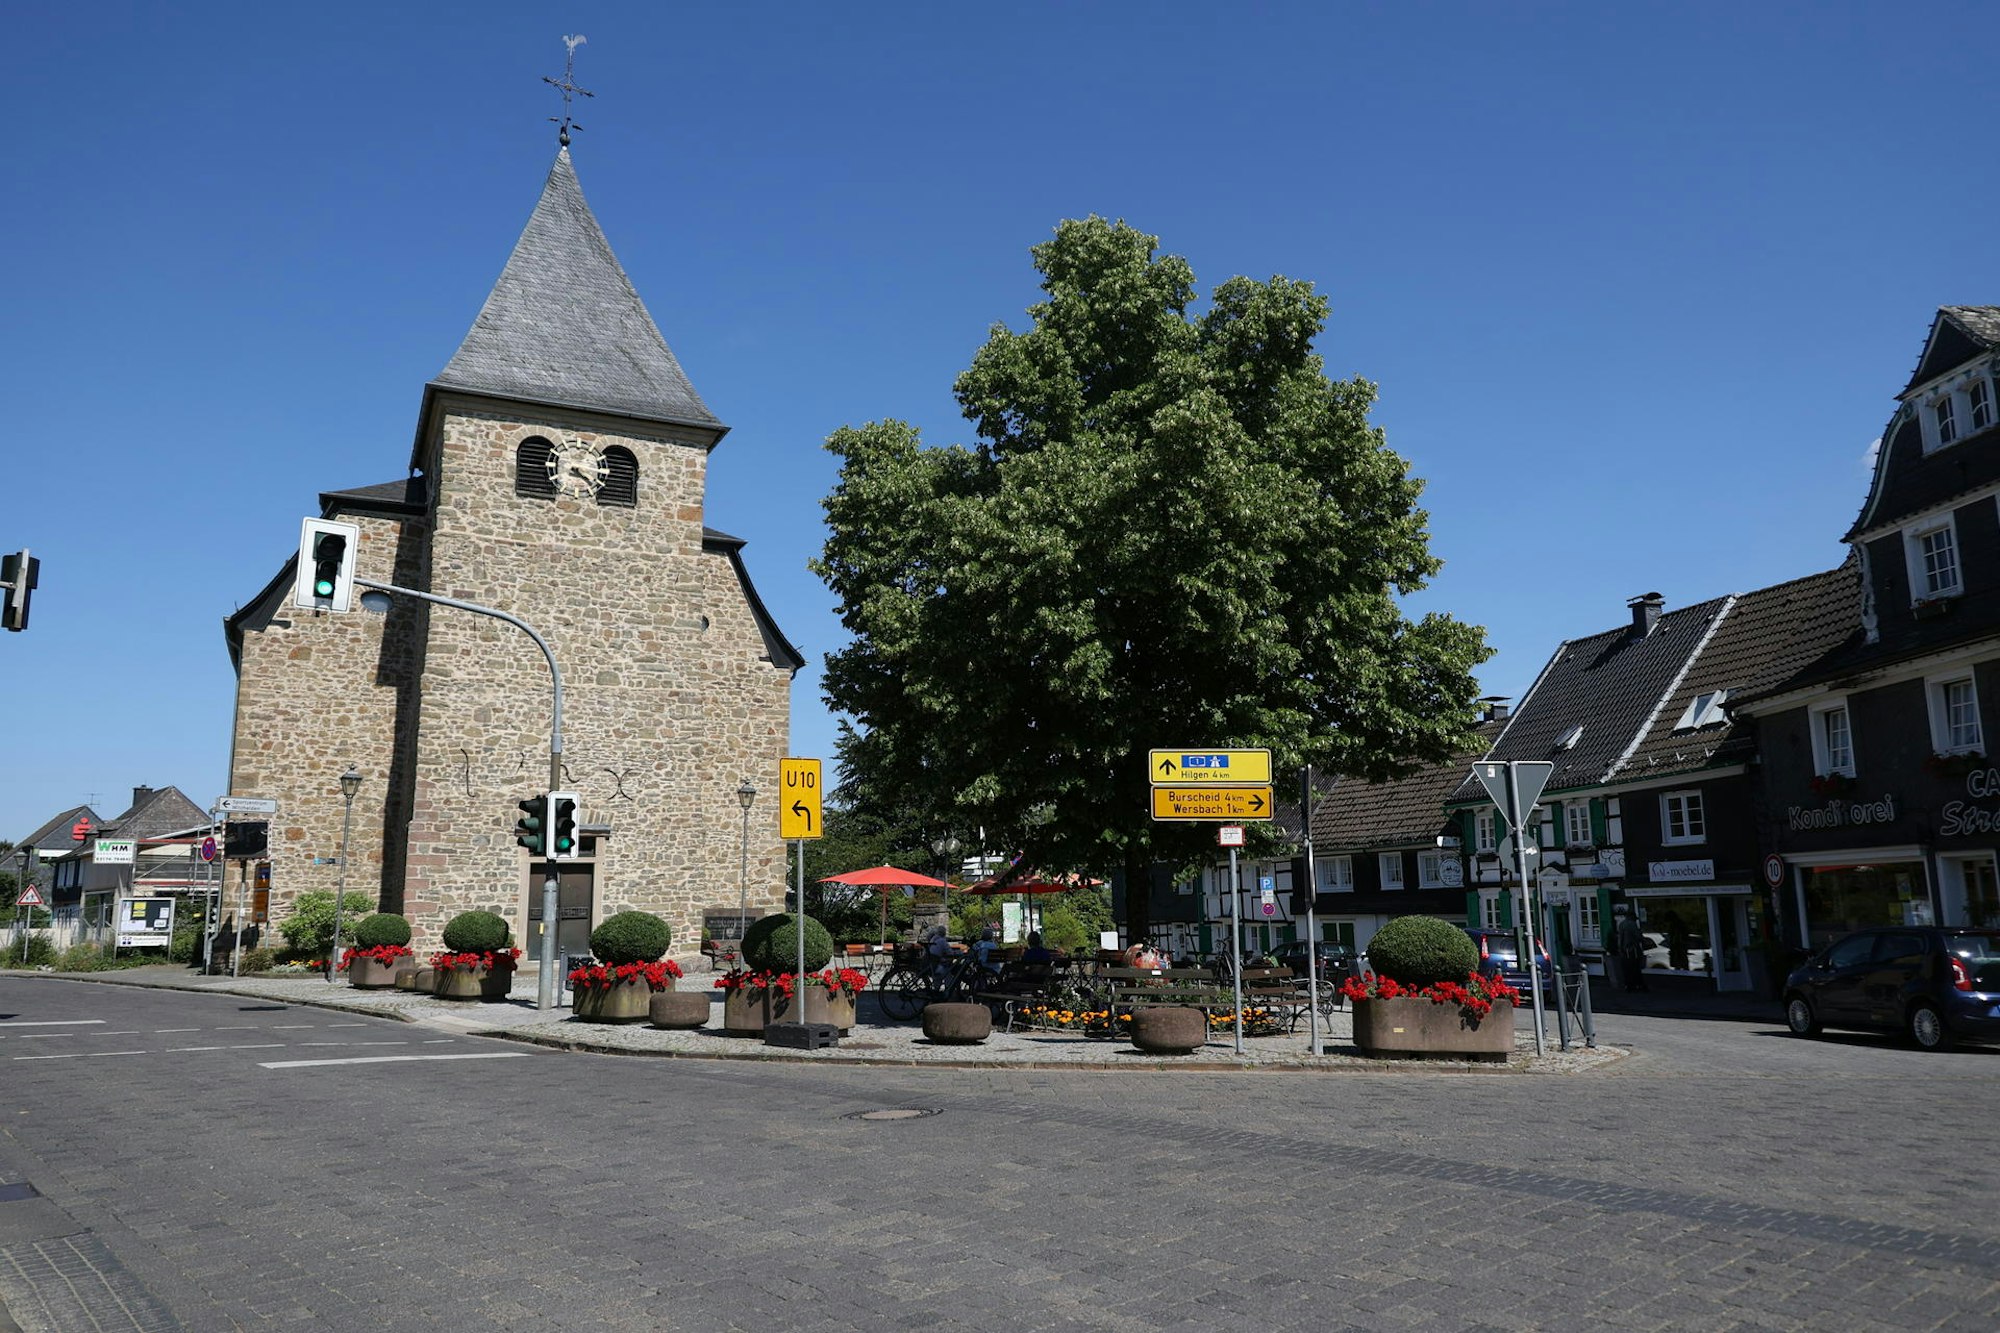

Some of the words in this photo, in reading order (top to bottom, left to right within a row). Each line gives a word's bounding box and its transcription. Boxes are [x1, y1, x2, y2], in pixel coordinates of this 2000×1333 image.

[787, 770, 815, 788] U10
[1181, 771, 1209, 780] Hilgen
[1168, 791, 1220, 802] Burscheid
[1173, 803, 1223, 814] Wersbach
[97, 842, 129, 852] WHM
[1769, 863, 1779, 877] 10
